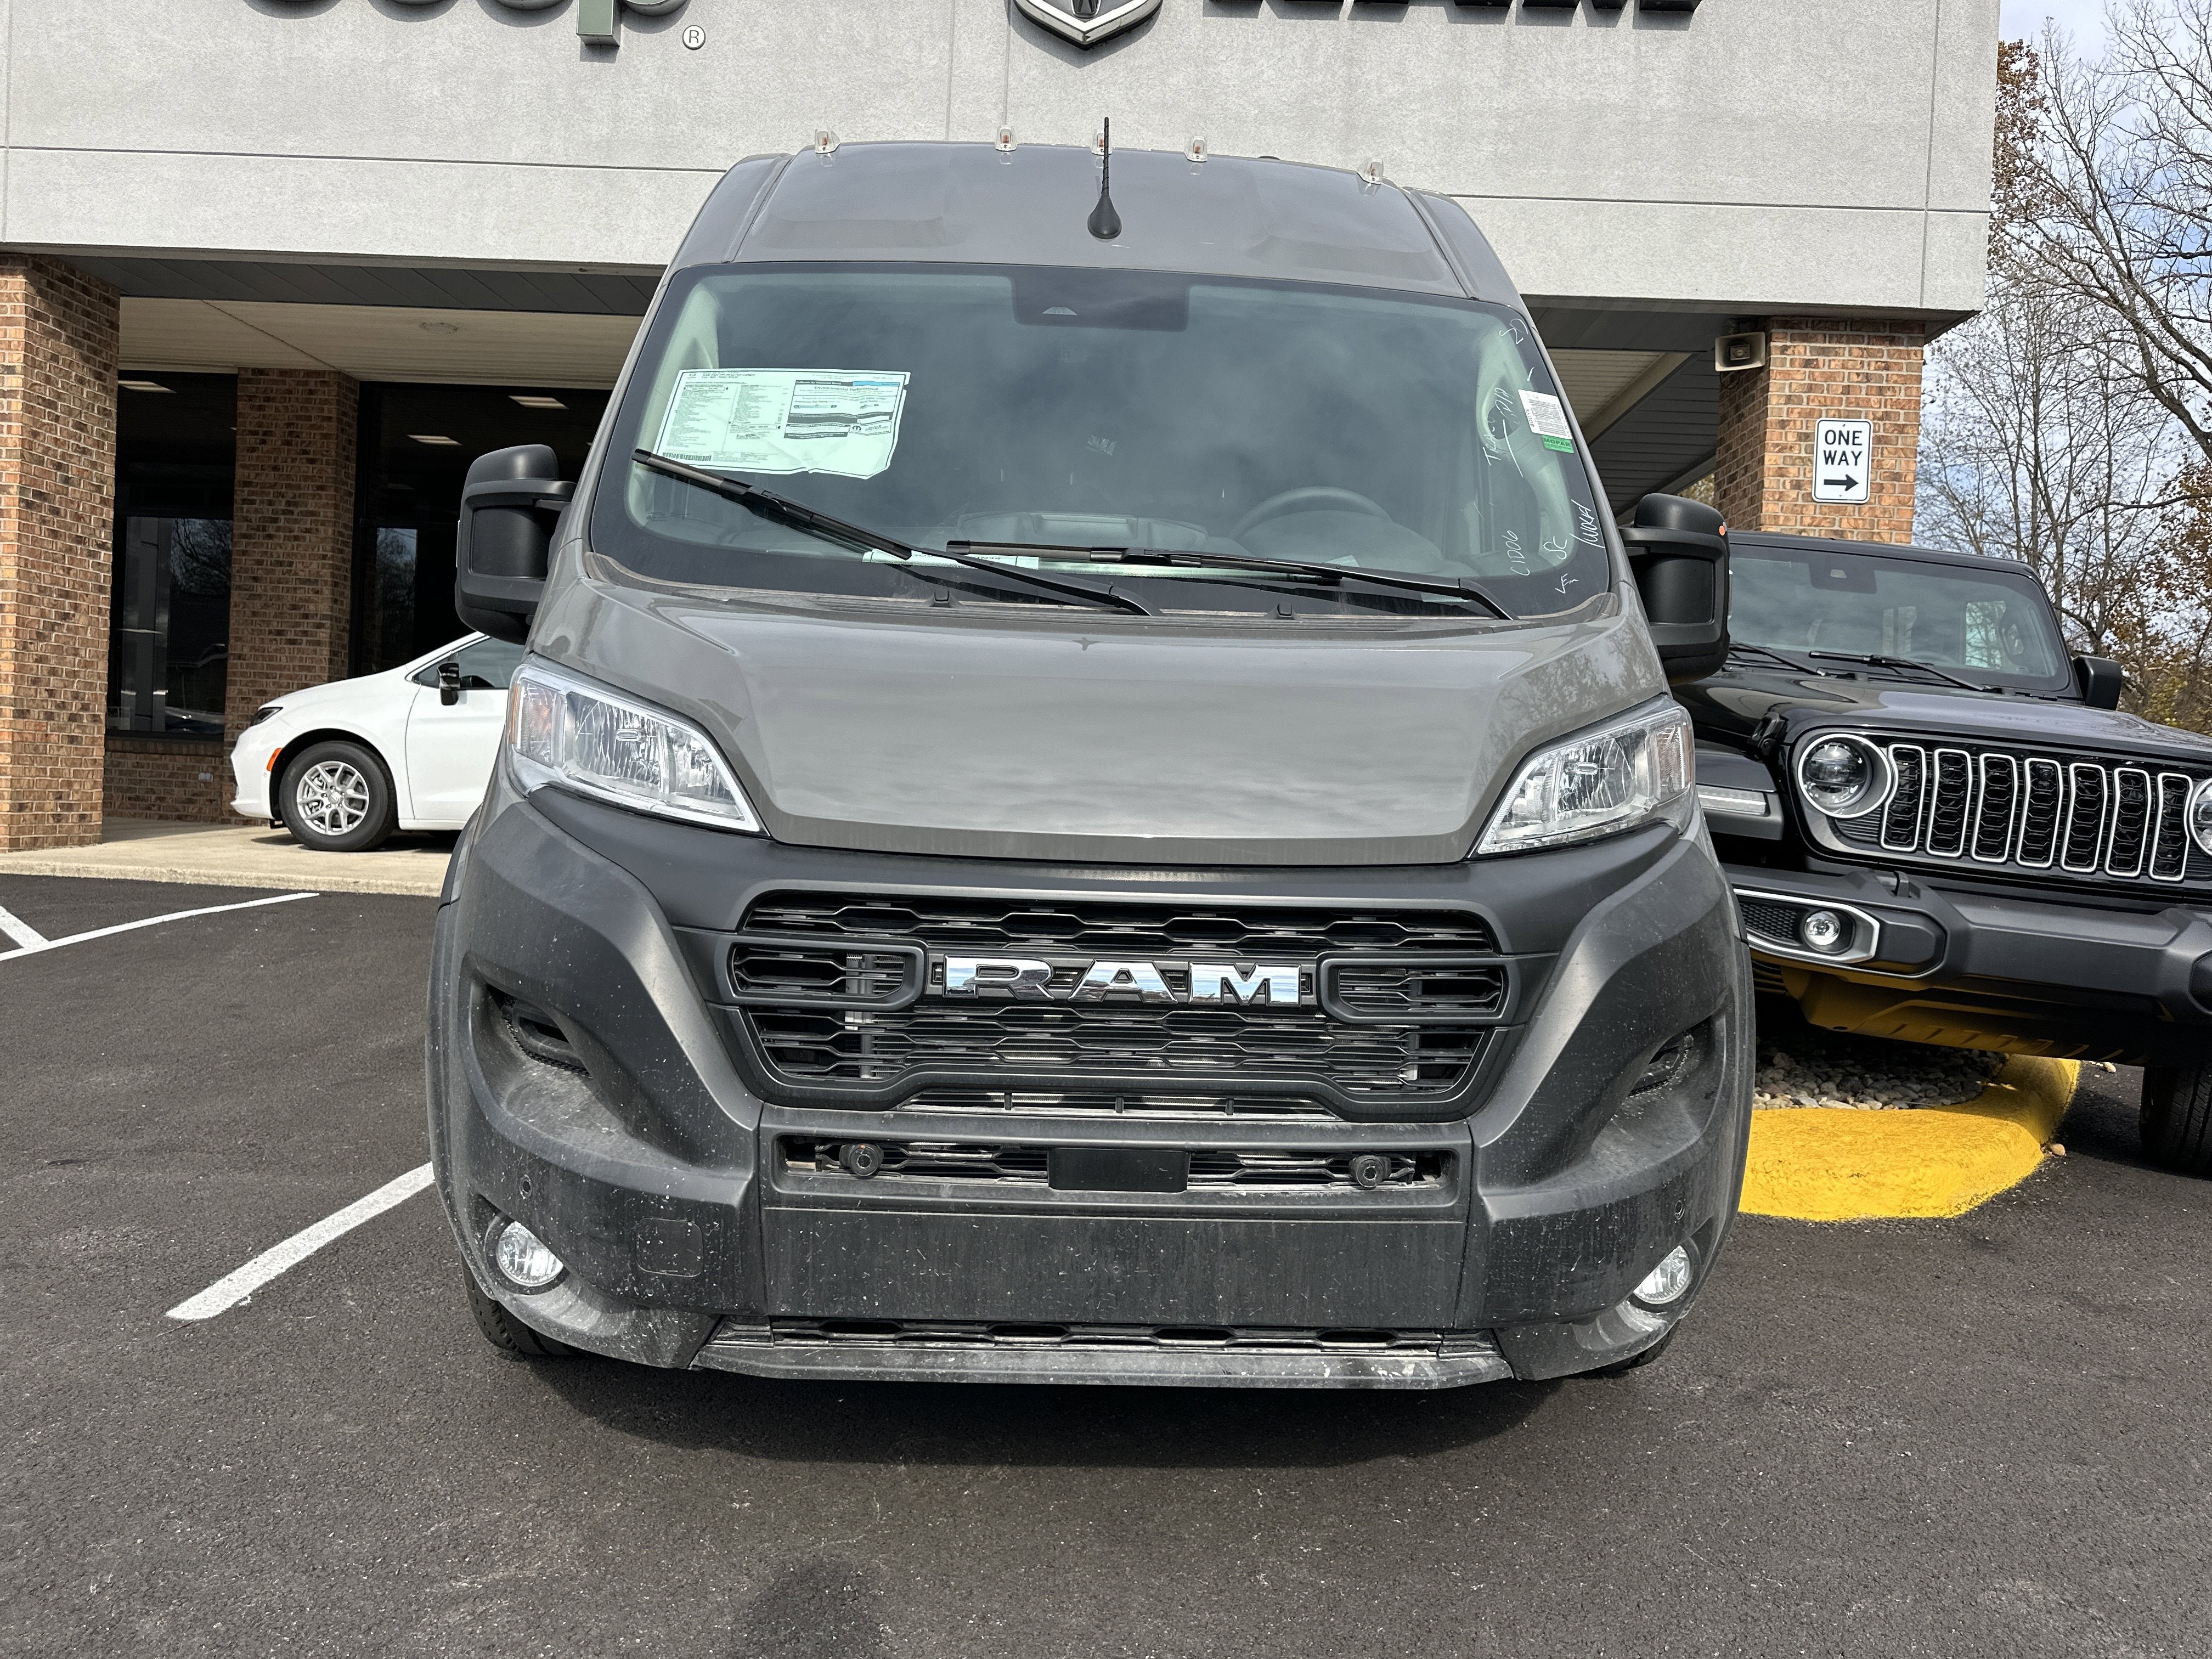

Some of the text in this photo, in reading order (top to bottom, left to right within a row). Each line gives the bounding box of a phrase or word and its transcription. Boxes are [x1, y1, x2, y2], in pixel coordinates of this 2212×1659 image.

[1543, 437, 1571, 448] MOPAR
[1825, 430, 1863, 446] ONE
[1823, 450, 1863, 466] WAY
[941, 953, 1301, 1006] RAM
